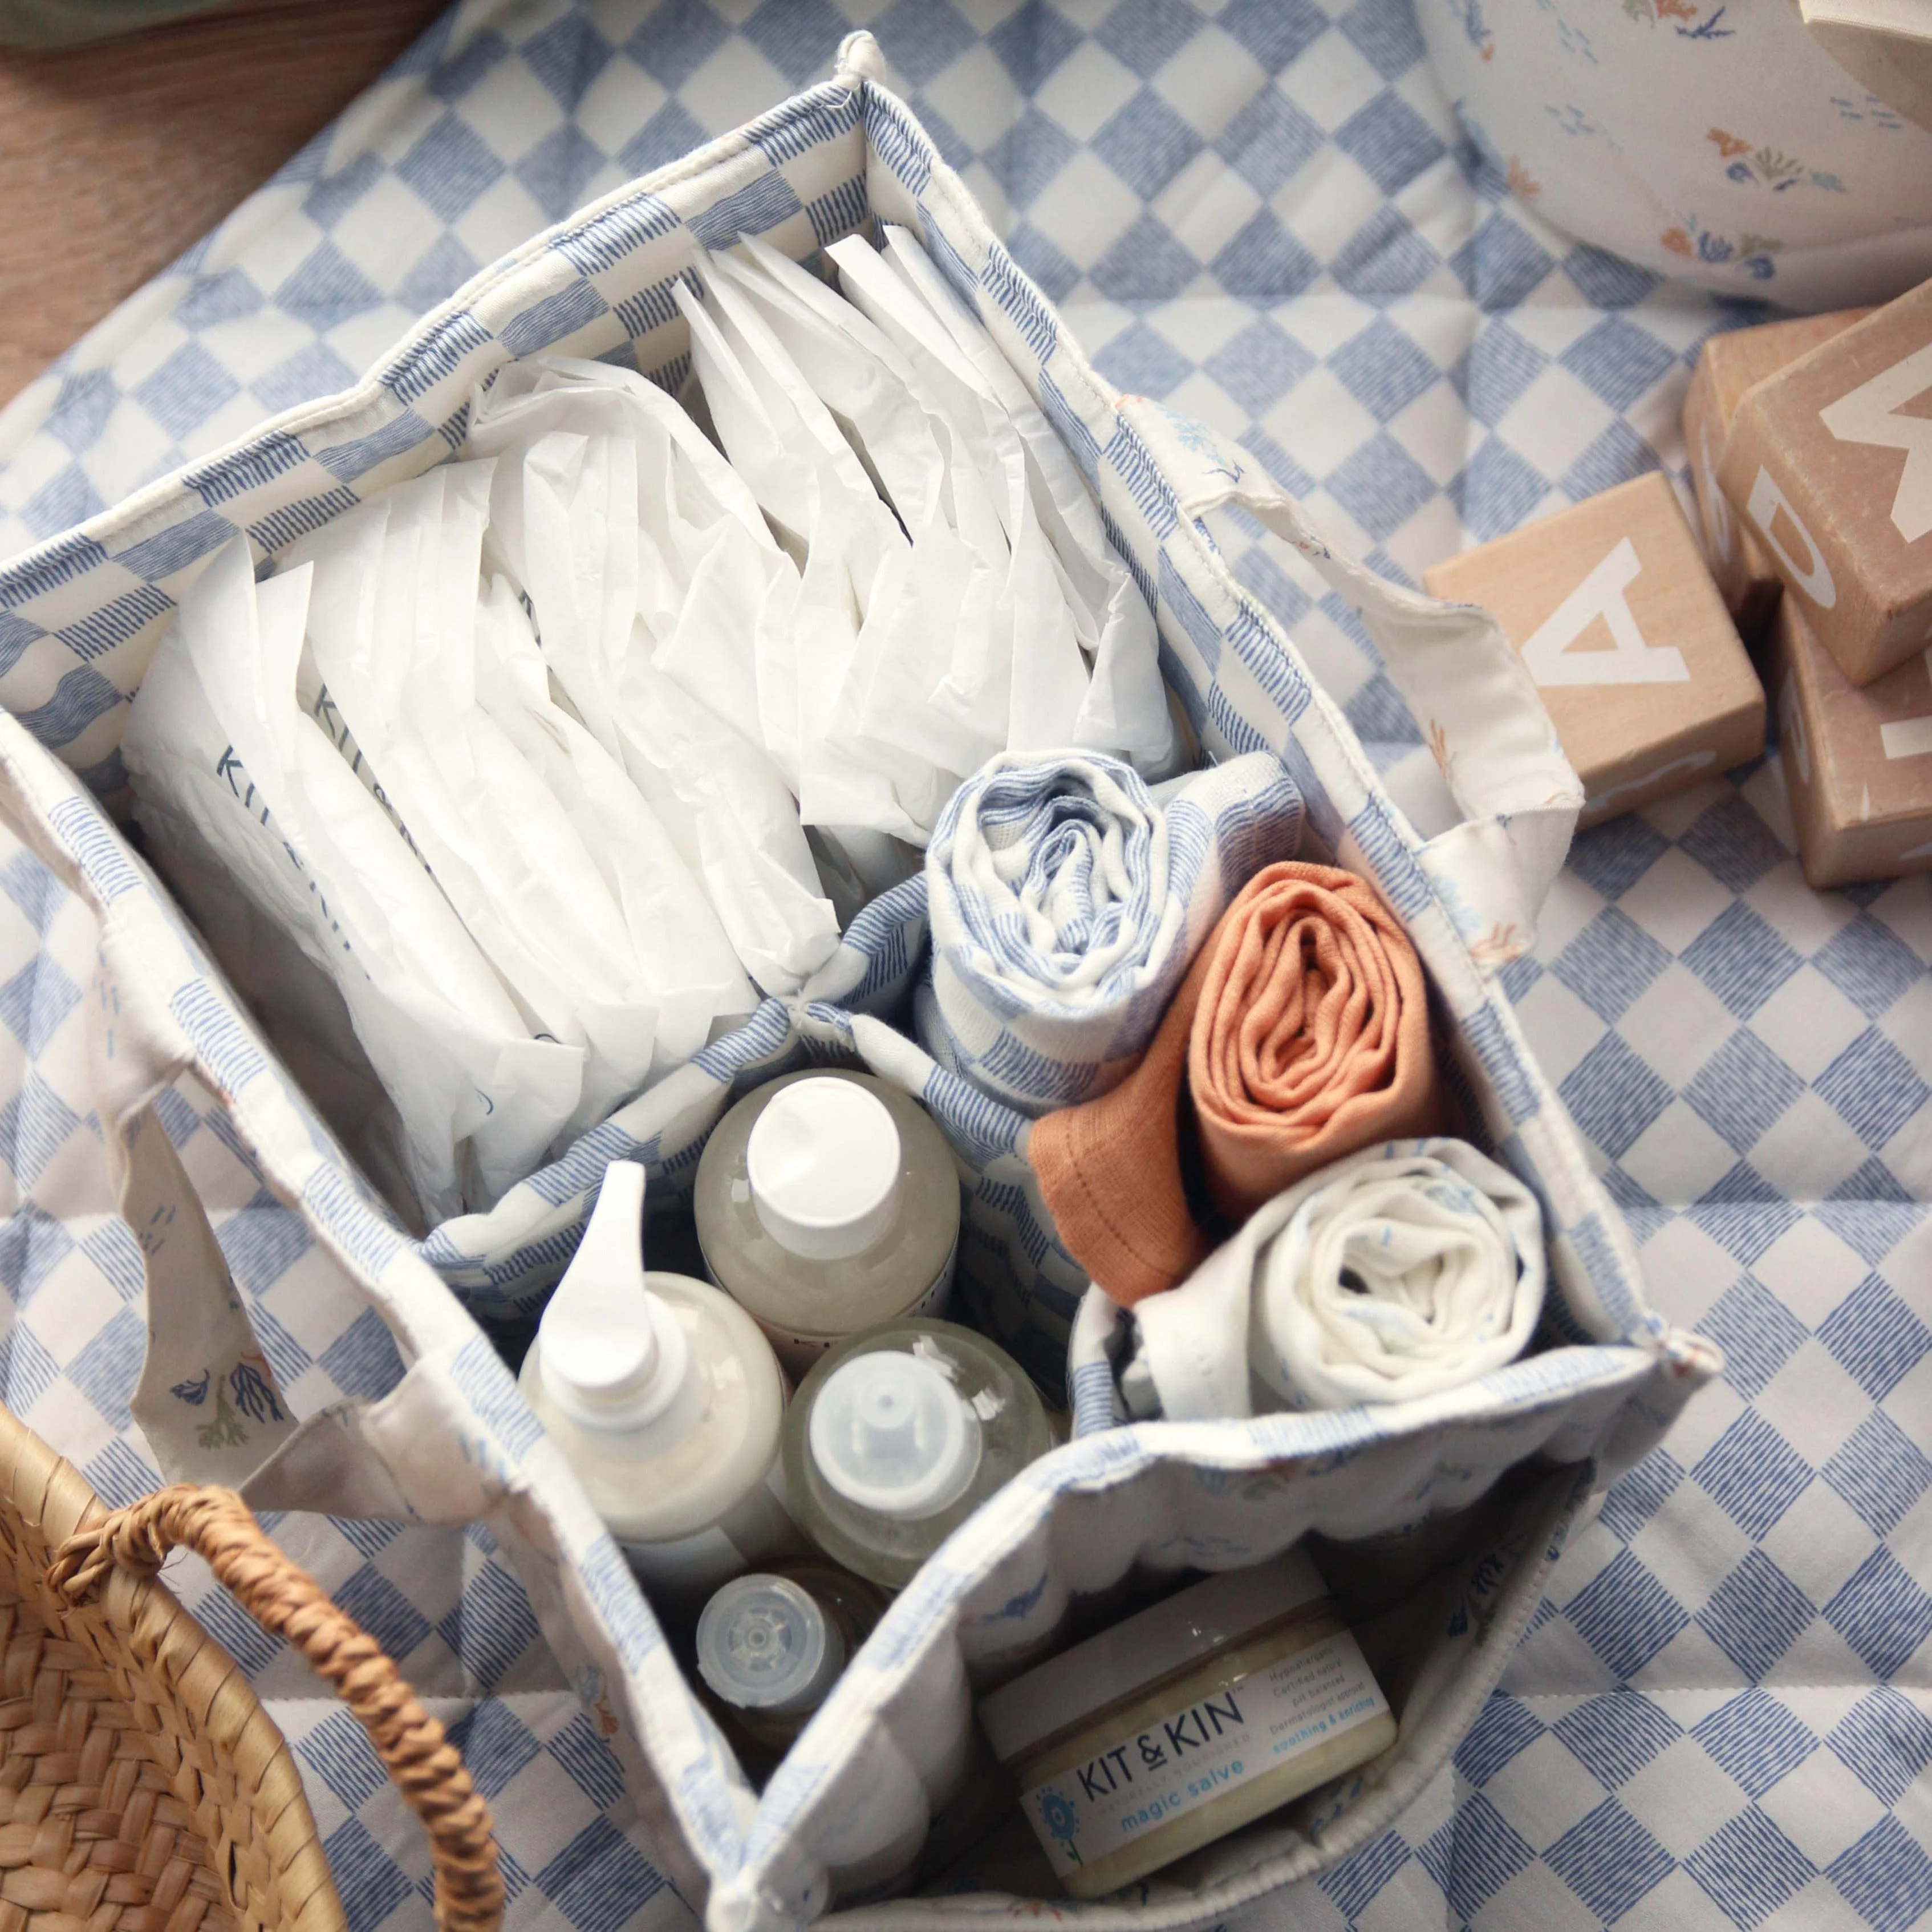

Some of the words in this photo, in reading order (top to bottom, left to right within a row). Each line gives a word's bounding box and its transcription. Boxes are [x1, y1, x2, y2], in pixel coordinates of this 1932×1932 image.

[1519, 536, 1691, 688] A
[1076, 1745, 1133, 1802] KIT
[1137, 1734, 1168, 1772] &
[1163, 1691, 1244, 1756] KIN
[1273, 1720, 1327, 1755] soothing
[1121, 1792, 1181, 1832] magic
[1187, 1760, 1244, 1797] salve
